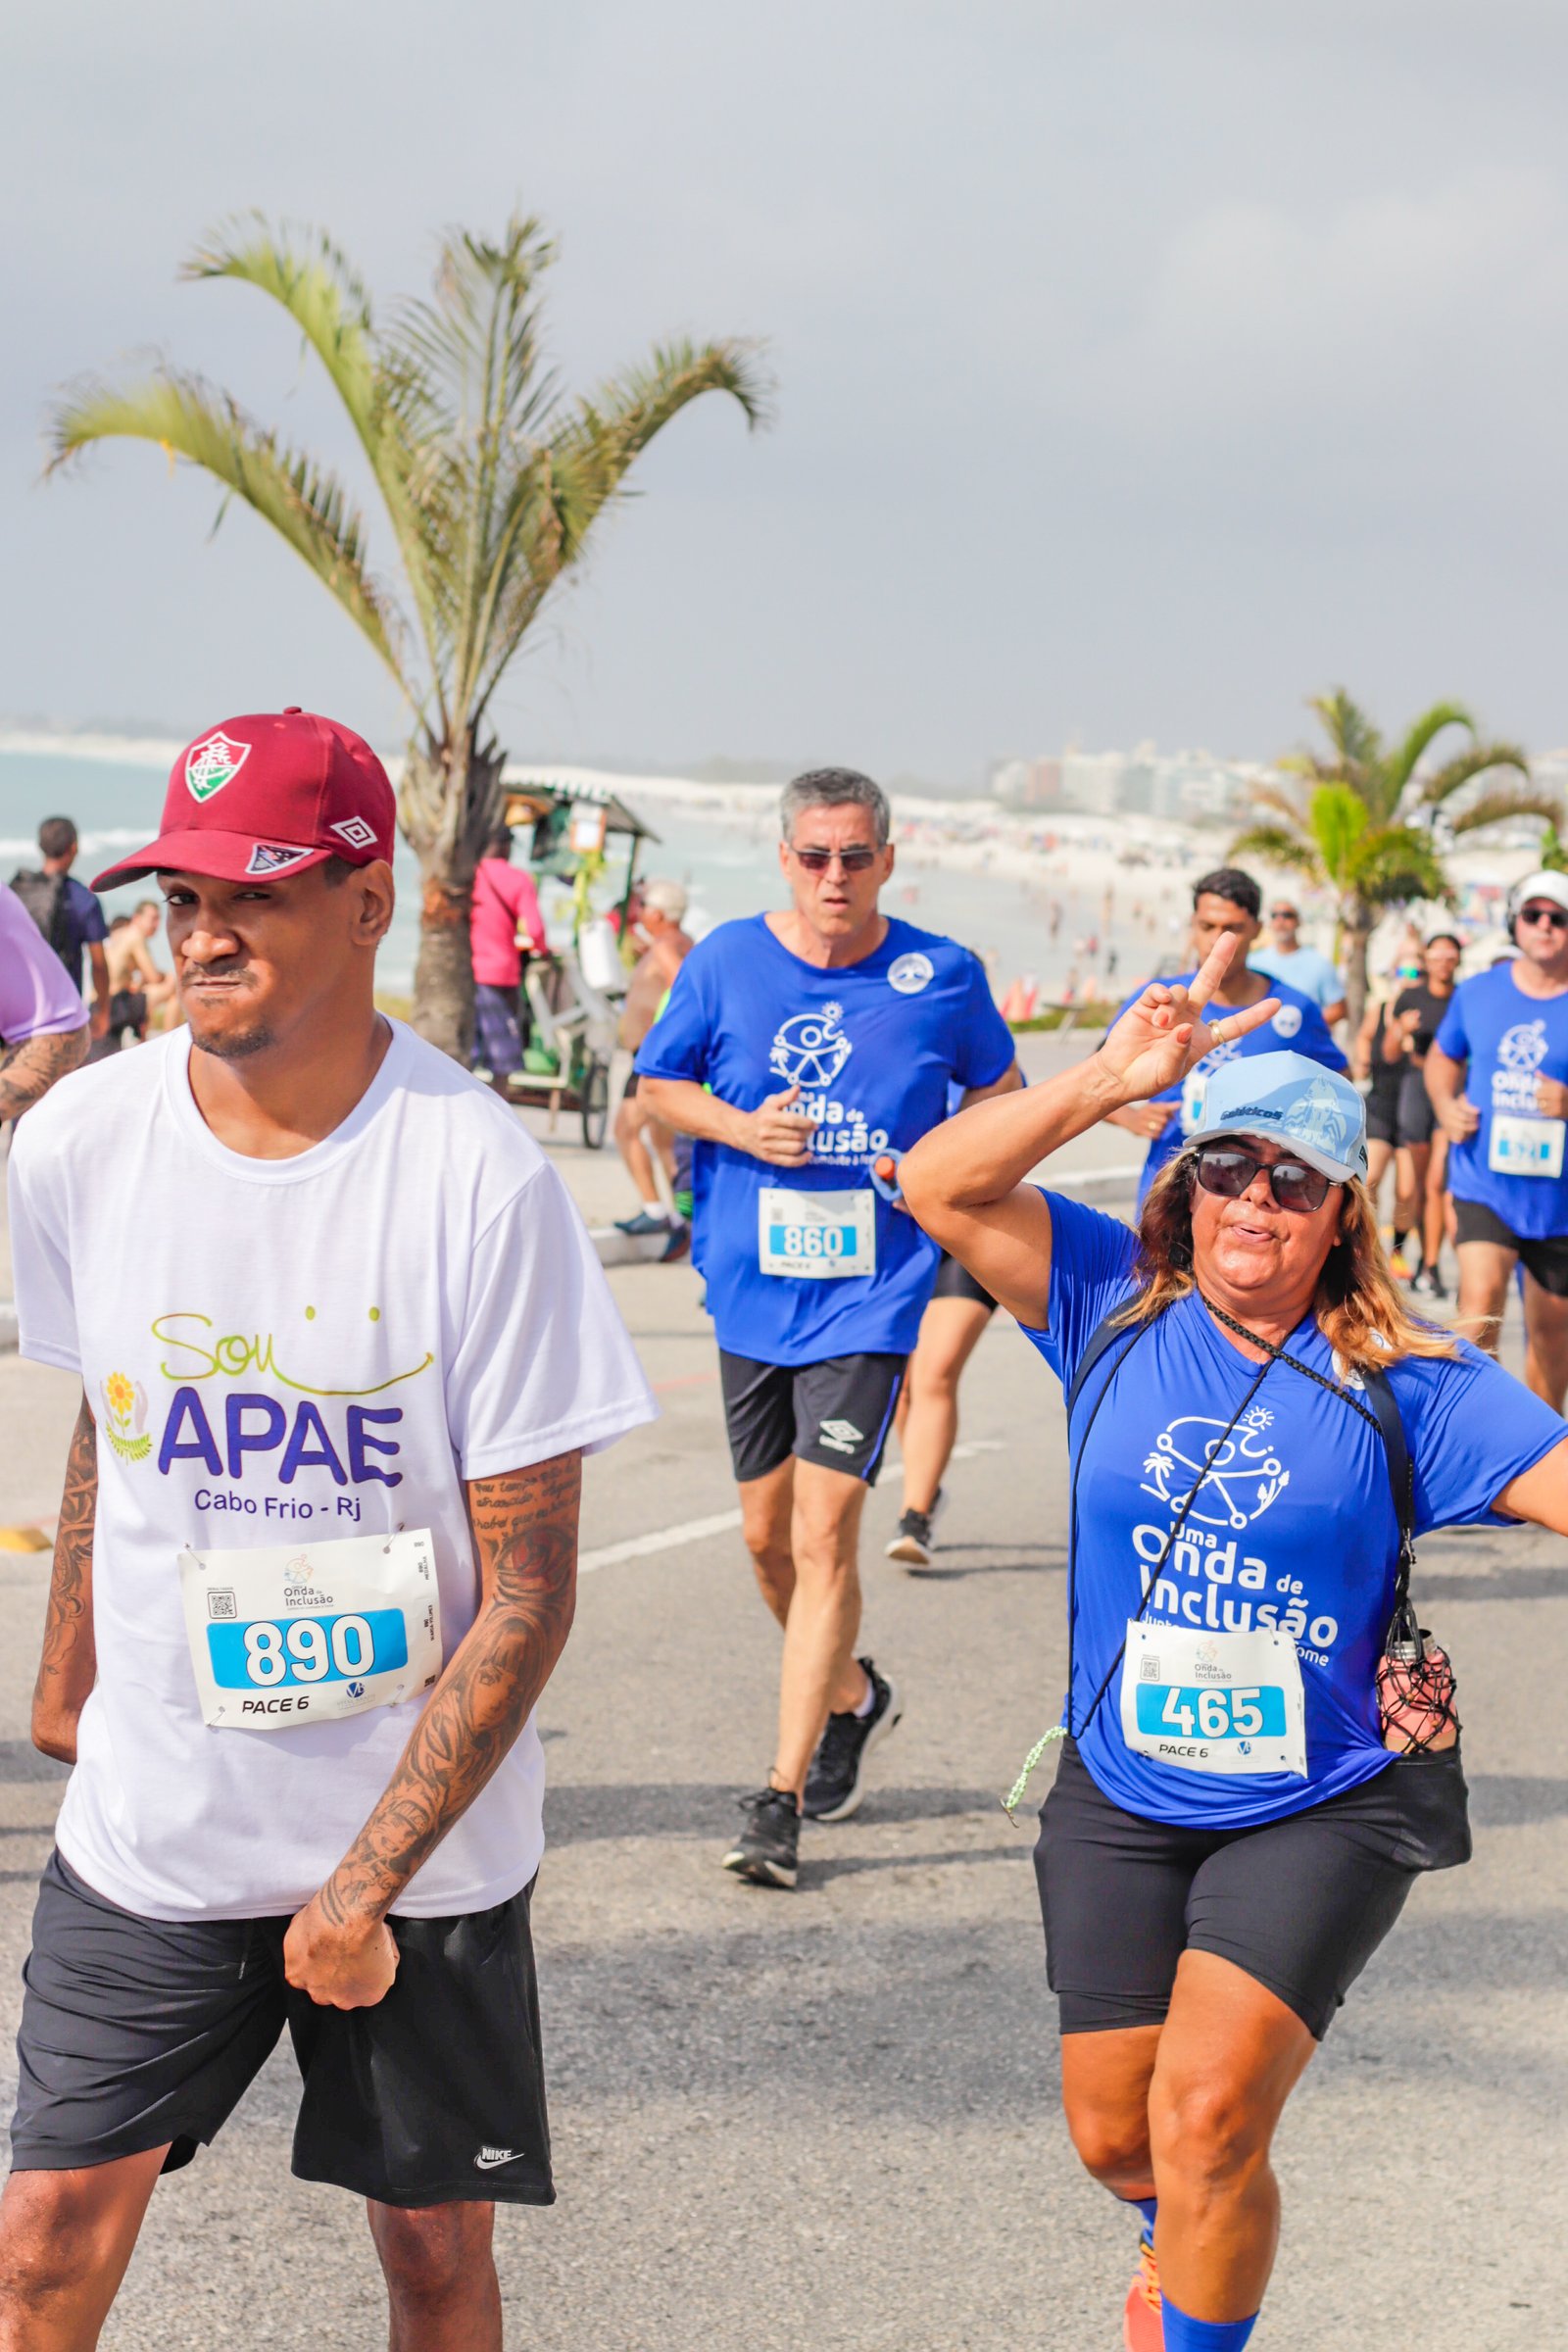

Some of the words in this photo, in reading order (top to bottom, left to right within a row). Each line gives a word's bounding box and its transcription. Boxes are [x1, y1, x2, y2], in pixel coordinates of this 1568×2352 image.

[784, 1094, 844, 1124] nda
[807, 1122, 889, 1153] lusão
[784, 1225, 844, 1257] 860
[158, 1386, 404, 1488] APAE
[194, 1489, 258, 1515] Cabo
[265, 1496, 314, 1519] Frio
[337, 1496, 362, 1522] Rj
[1169, 1520, 1217, 1549] Uma
[1132, 1523, 1267, 1591] Onda
[1276, 1574, 1303, 1596] de
[283, 1586, 315, 1597] Onda
[285, 1594, 334, 1606] Inclusão
[1140, 1564, 1339, 1649] Inclusão
[243, 1614, 375, 1688] 890
[1295, 1641, 1330, 1667] ome
[1194, 1663, 1218, 1672] Onda
[1195, 1670, 1232, 1680] Inclusão
[242, 1697, 293, 1714] PACE
[297, 1695, 310, 1711] 6
[1161, 1686, 1264, 1739] 465
[1158, 1743, 1198, 1757] PACE
[1200, 1747, 1209, 1758] 6
[482, 2147, 512, 2161] NIKE
